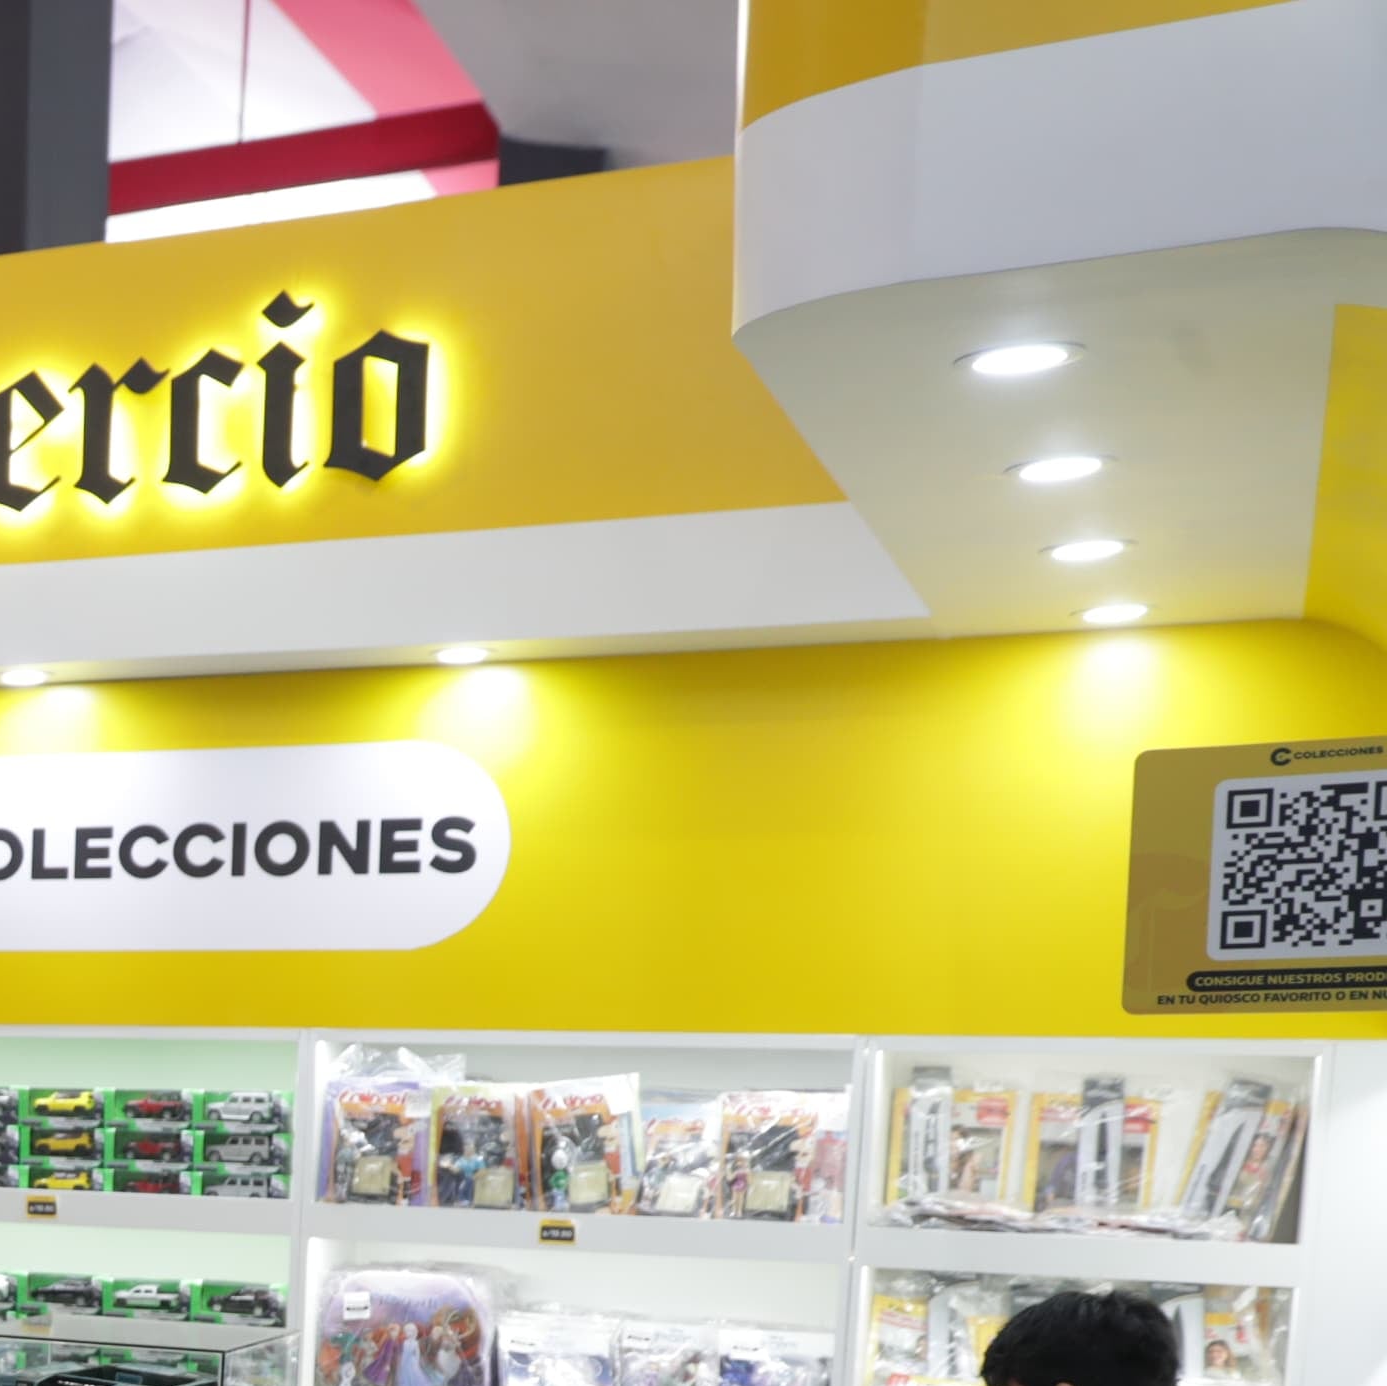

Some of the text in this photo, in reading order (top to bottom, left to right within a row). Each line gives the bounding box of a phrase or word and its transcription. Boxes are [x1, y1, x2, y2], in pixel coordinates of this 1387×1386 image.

[1293, 745, 1385, 761] COLECCIONES
[1194, 974, 1265, 988] CONSIGUE
[1267, 972, 1342, 985] NUESTROS
[1157, 994, 1176, 1006] EN
[1179, 993, 1197, 1005] TU
[1199, 991, 1261, 1005] QUIOSCO
[1264, 990, 1332, 1003] FAVORITO
[1336, 990, 1346, 1002] O
[1349, 988, 1368, 1002] EN
